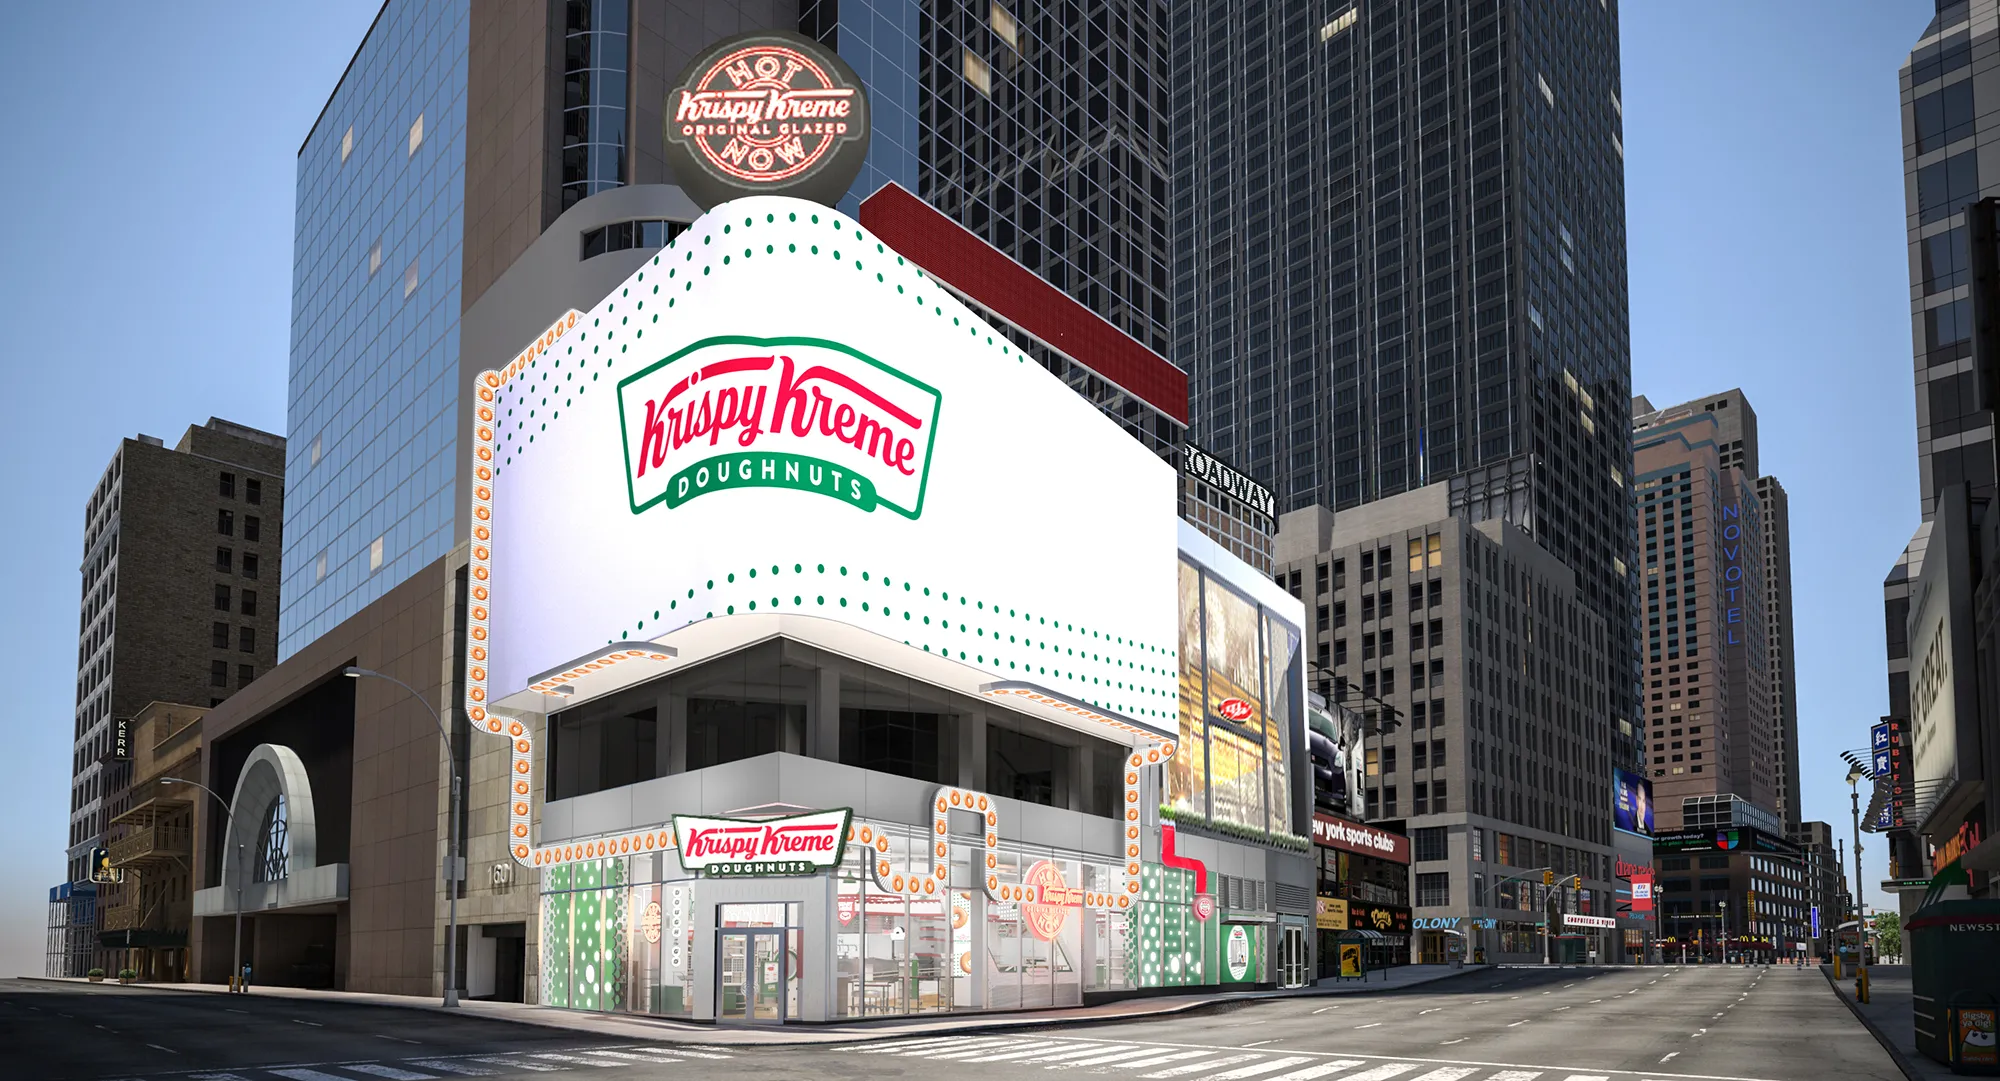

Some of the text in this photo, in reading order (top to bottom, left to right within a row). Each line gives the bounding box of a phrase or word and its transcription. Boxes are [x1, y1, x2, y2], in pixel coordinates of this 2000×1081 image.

[725, 56, 803, 87] HOT
[675, 88, 854, 124] Krispy Kreme
[682, 122, 848, 136] ORIGINAL GLAZED
[720, 136, 805, 171] NOW
[637, 355, 922, 479] Krispy Kreme
[677, 459, 862, 501] DOUGHNUTS
[1723, 503, 1742, 645] NOVOTEL
[1912, 682, 1922, 741] BE
[1920, 616, 1948, 713] GREAT.
[116, 721, 126, 756] KERR
[685, 823, 838, 860] Krispy Kreme
[1325, 822, 1345, 841] york
[1346, 827, 1373, 847] sports
[1373, 832, 1394, 852] clubs
[1660, 834, 1682, 843] growth
[1683, 833, 1704, 841] today?
[488, 863, 515, 884] 1601
[711, 862, 806, 875] DOUGHNUTS
[1038, 870, 1059, 884] HOT
[1037, 916, 1060, 933] NOW
[1412, 917, 1460, 929] OLONY
[1949, 923, 2000, 932] NEWSST
[1962, 1011, 1991, 1021] digsby
[1975, 1019, 1991, 1028] dig!
